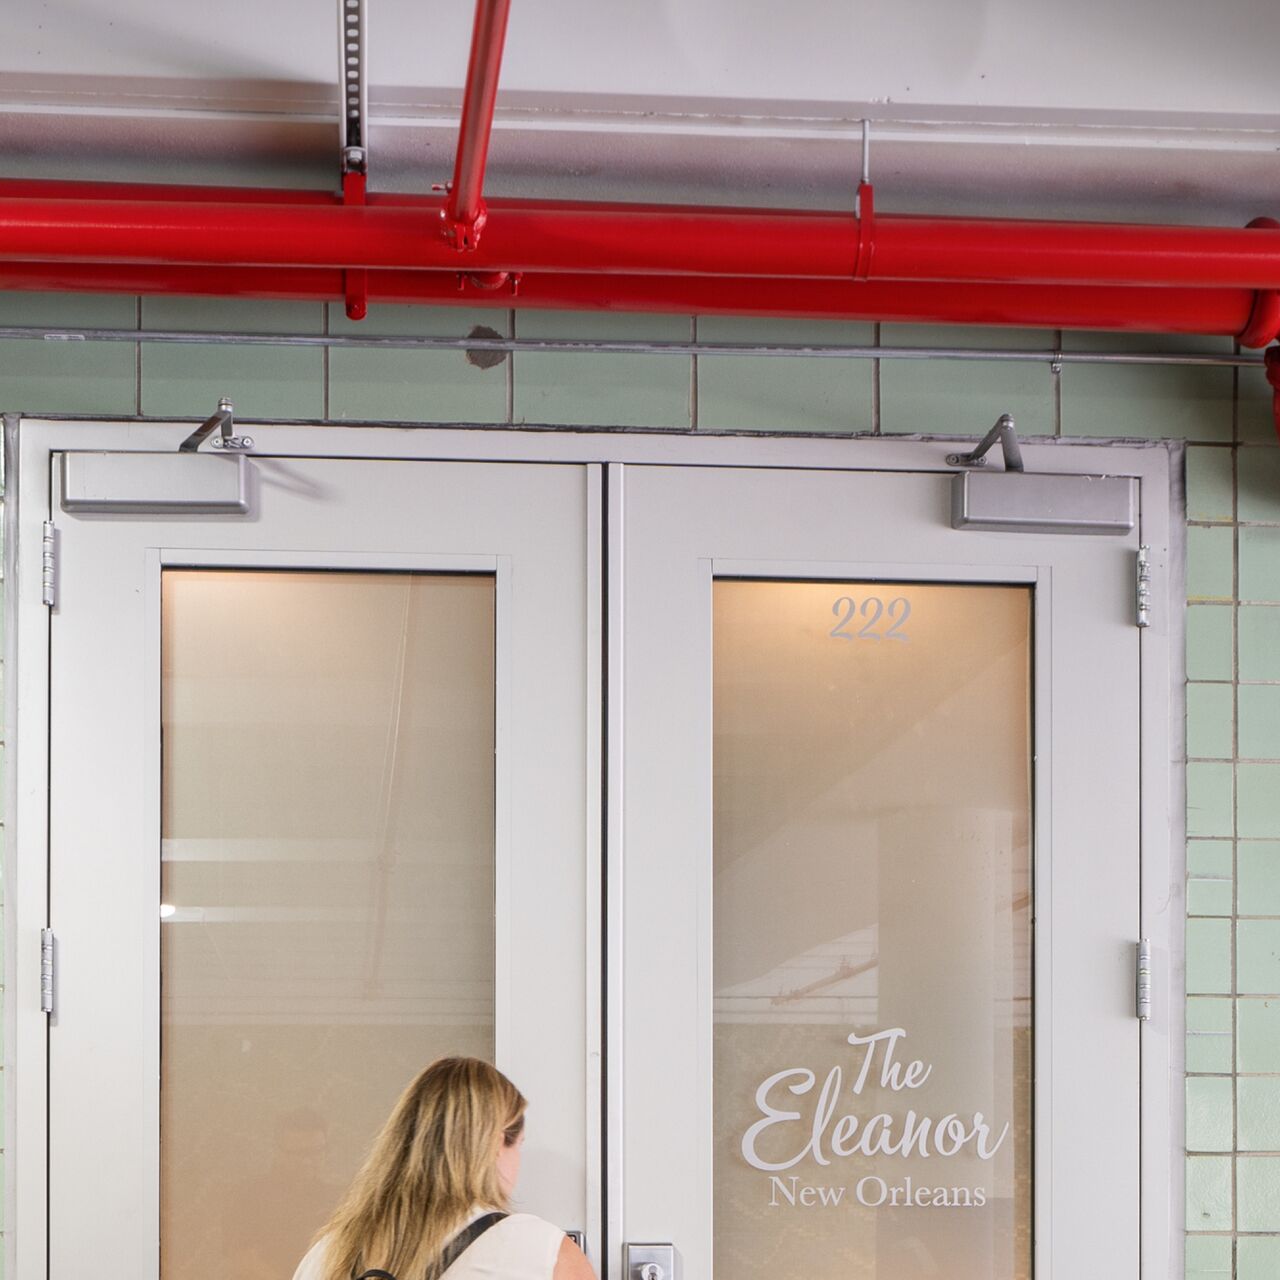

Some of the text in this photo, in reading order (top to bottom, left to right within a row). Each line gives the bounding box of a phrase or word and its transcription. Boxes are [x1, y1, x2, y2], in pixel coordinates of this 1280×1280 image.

[830, 596, 912, 641] 222
[847, 1028, 932, 1095] The
[741, 1065, 1009, 1171] Eleanor
[768, 1176, 986, 1207] New Orleans
